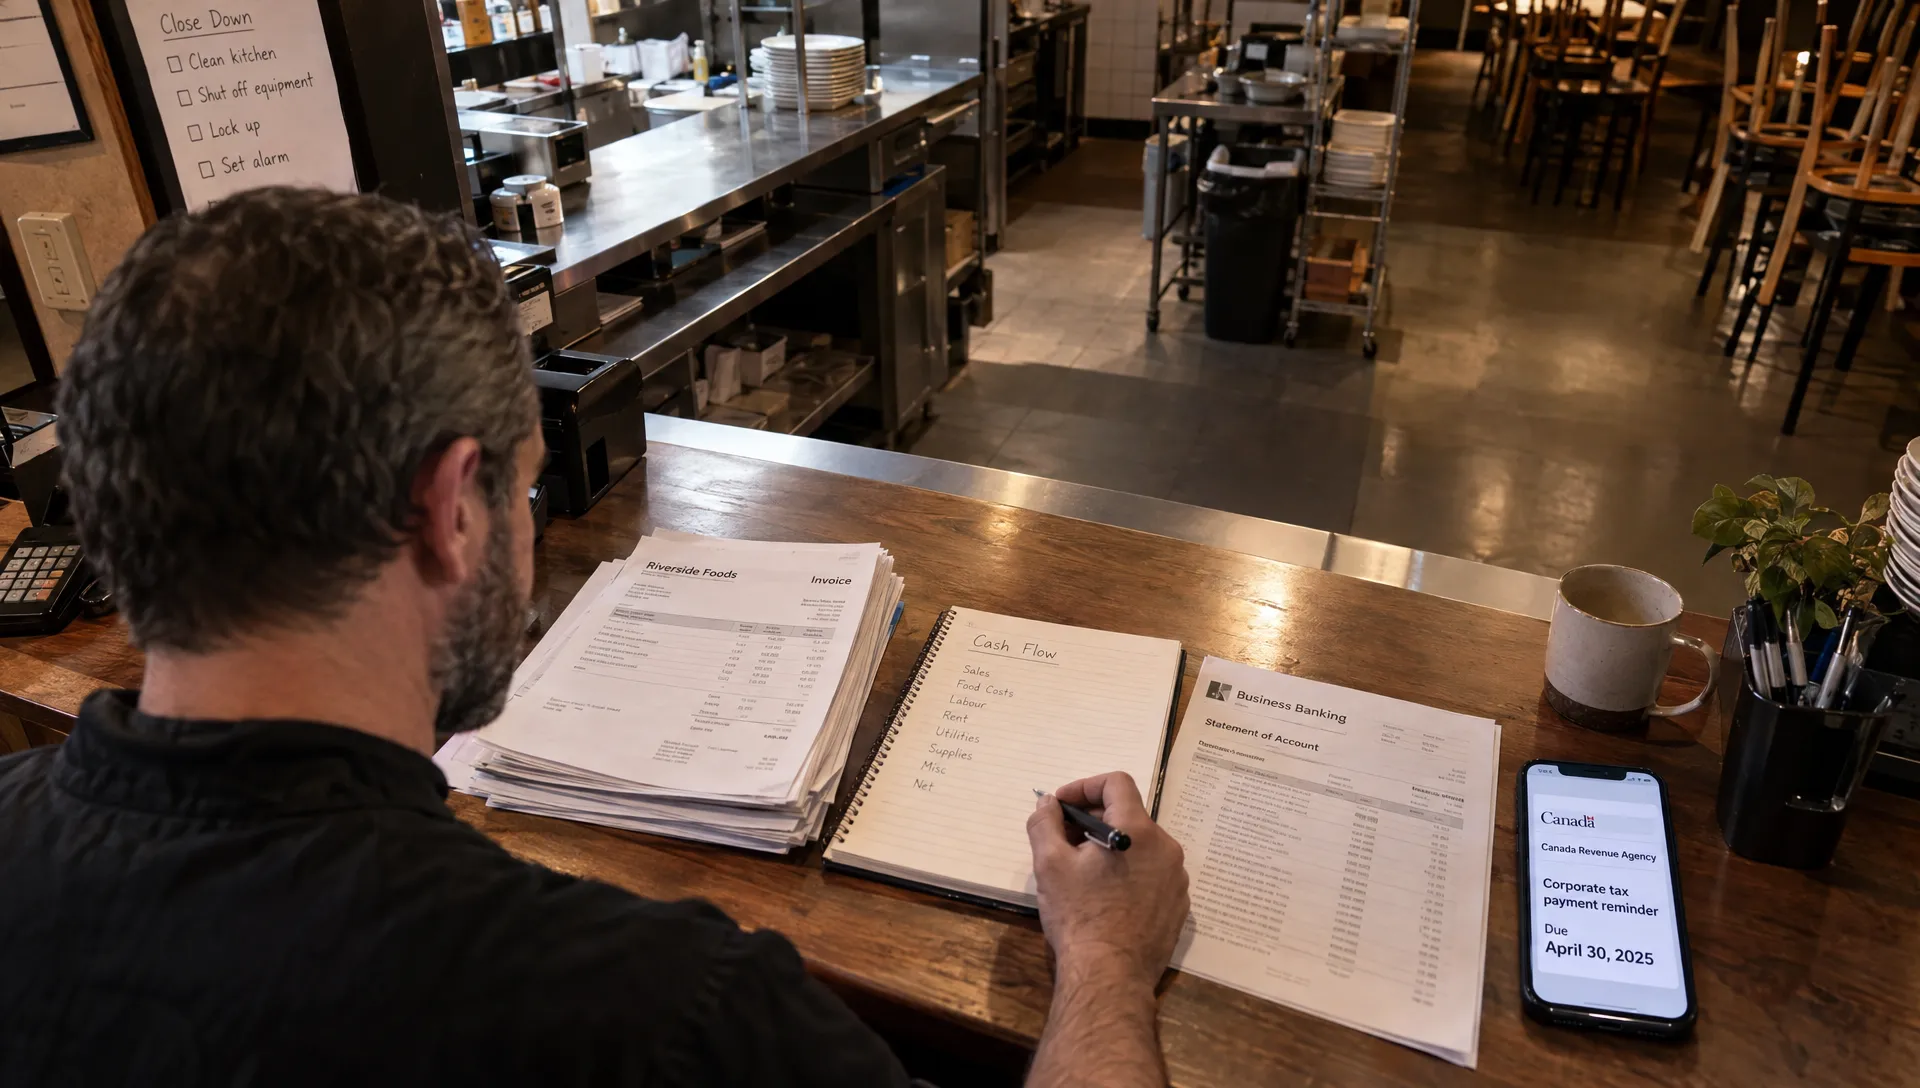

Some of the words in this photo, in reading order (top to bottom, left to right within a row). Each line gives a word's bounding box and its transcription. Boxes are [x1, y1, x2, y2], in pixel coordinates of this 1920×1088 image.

[161, 13, 202, 34] Close
[209, 10, 252, 28] Down
[189, 52, 225, 70] Clean
[230, 46, 277, 64] kitchen
[198, 85, 227, 103] Shut
[233, 80, 247, 98] off
[255, 72, 313, 100] equipment
[209, 119, 239, 138] Lock
[246, 121, 260, 137] up
[222, 156, 245, 174] Set
[254, 150, 289, 168] alarm
[646, 561, 700, 576] Riverside
[702, 569, 738, 579] Foods
[811, 576, 851, 585] Invoice
[973, 634, 1010, 652] Cash
[1023, 643, 1057, 659] Flow
[963, 665, 990, 677] Sales
[957, 680, 980, 692] Food
[986, 685, 1014, 698] Costs
[950, 695, 987, 709] Labour
[1237, 691, 1291, 710] Business
[1295, 704, 1347, 724] Banking
[943, 711, 969, 724] Rent
[936, 727, 980, 743] Utilities
[1205, 718, 1259, 737] Statement
[1261, 732, 1272, 740] of
[1275, 735, 1319, 751] Account
[929, 743, 973, 761] Supplies
[921, 761, 946, 775] Misc
[913, 779, 935, 792] Net
[1541, 811, 1595, 828] Canada
[1541, 843, 1577, 854] Canada
[1579, 847, 1619, 858] Revenue
[1621, 851, 1656, 863] Agency
[1543, 878, 1606, 894] Corporate
[1610, 885, 1629, 897] tax
[1544, 895, 1598, 911] payment
[1602, 903, 1658, 916] reminder
[1545, 923, 1568, 936] Due
[1546, 941, 1582, 957] April
[1587, 945, 1611, 962] 30,
[1615, 949, 1654, 965] 2025
